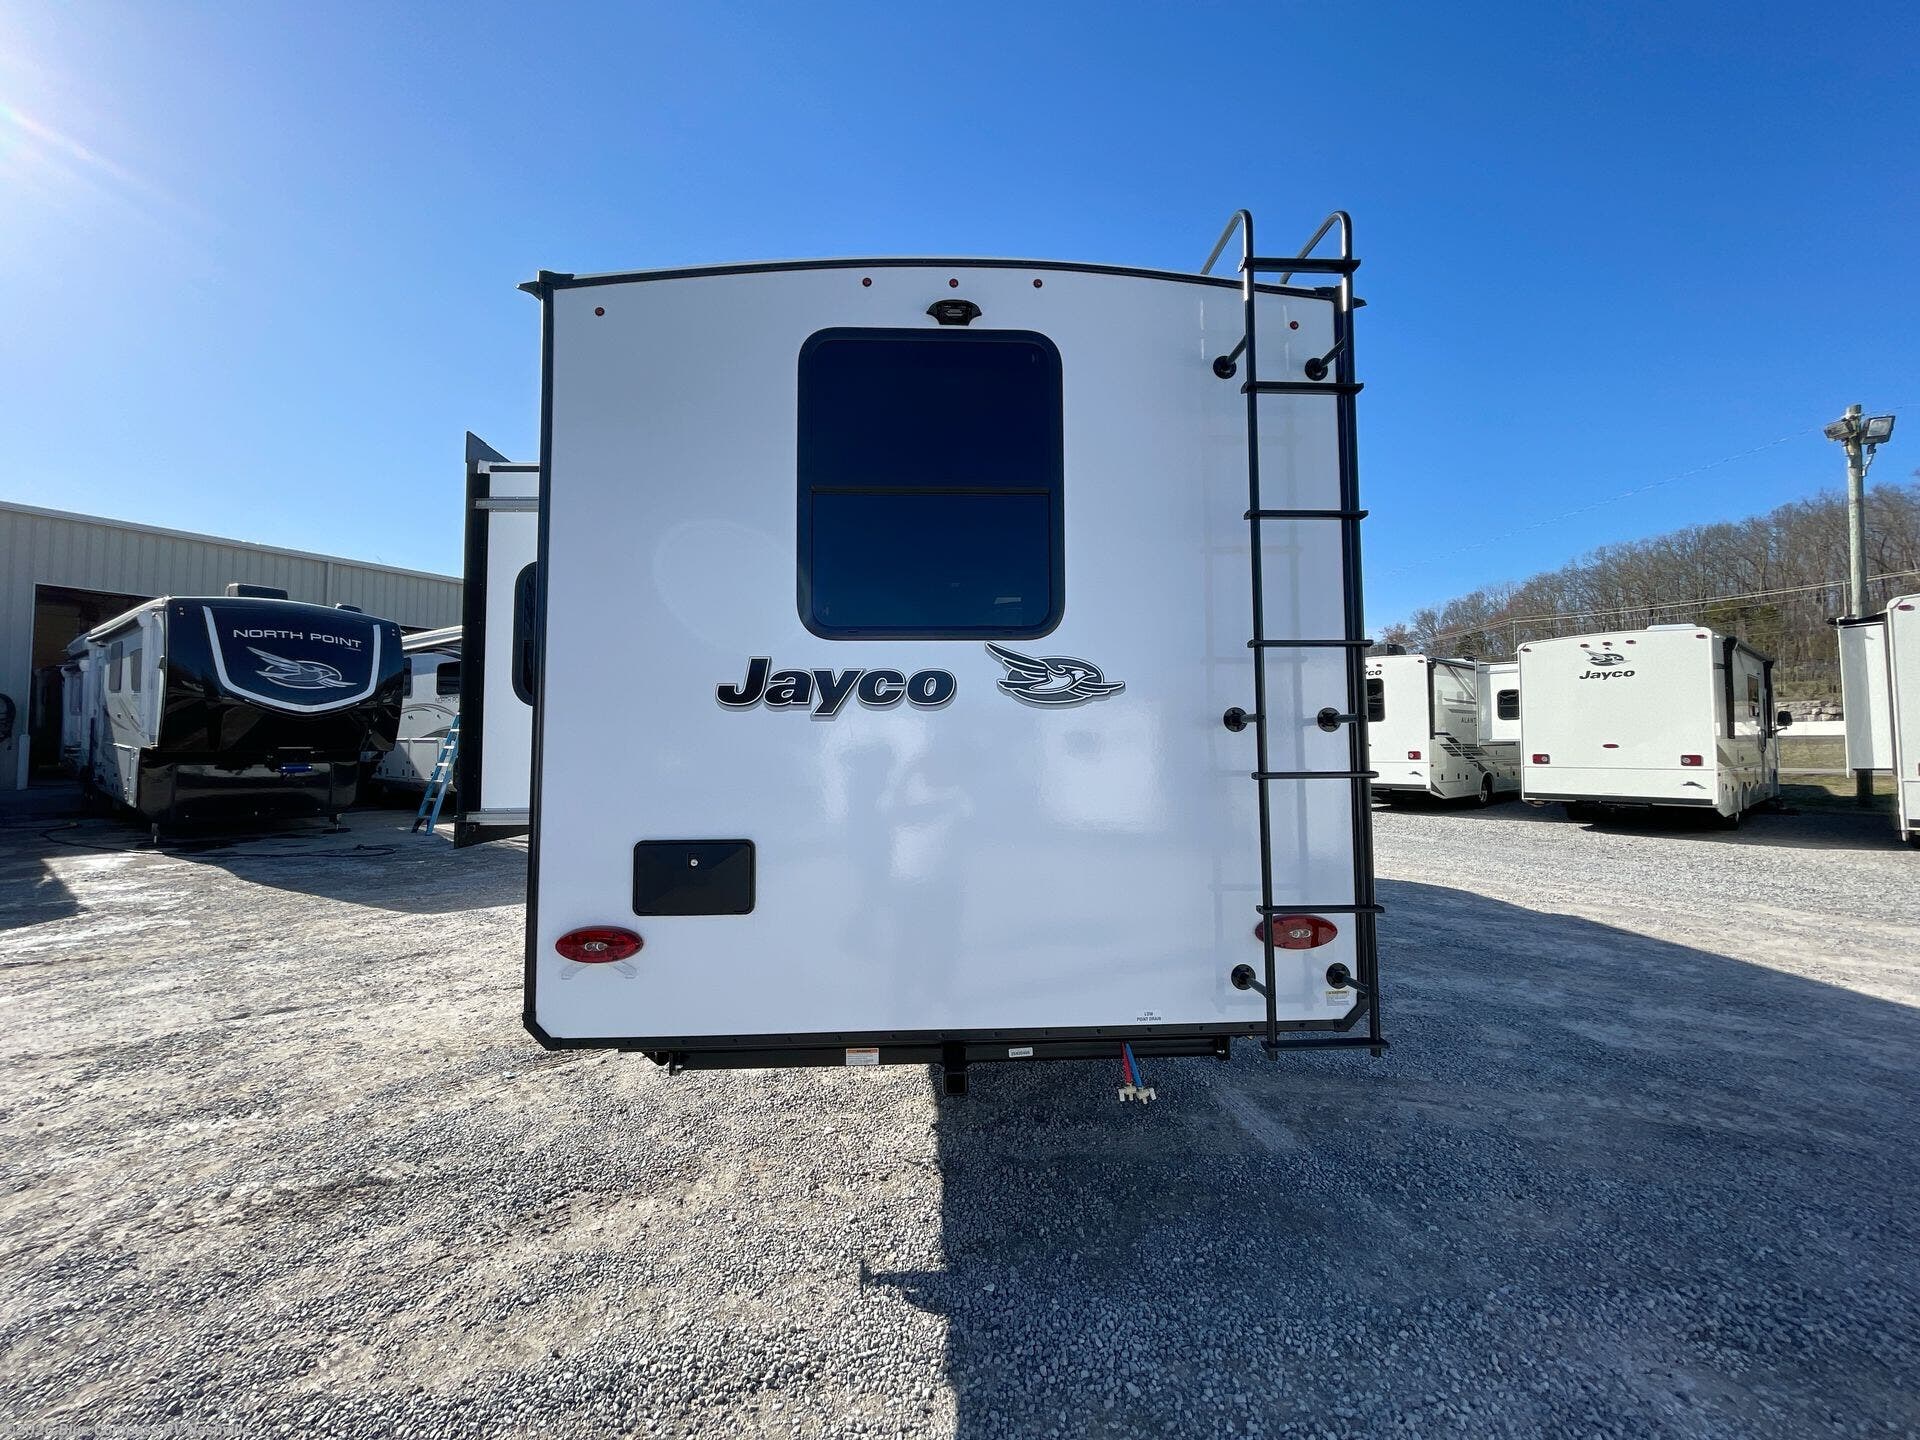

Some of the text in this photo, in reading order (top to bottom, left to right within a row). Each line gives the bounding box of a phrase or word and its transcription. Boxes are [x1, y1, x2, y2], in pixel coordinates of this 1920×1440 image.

[233, 629, 362, 648] NORTH POINT
[1579, 670, 1636, 680] Jayco
[717, 655, 957, 721] Jayco
